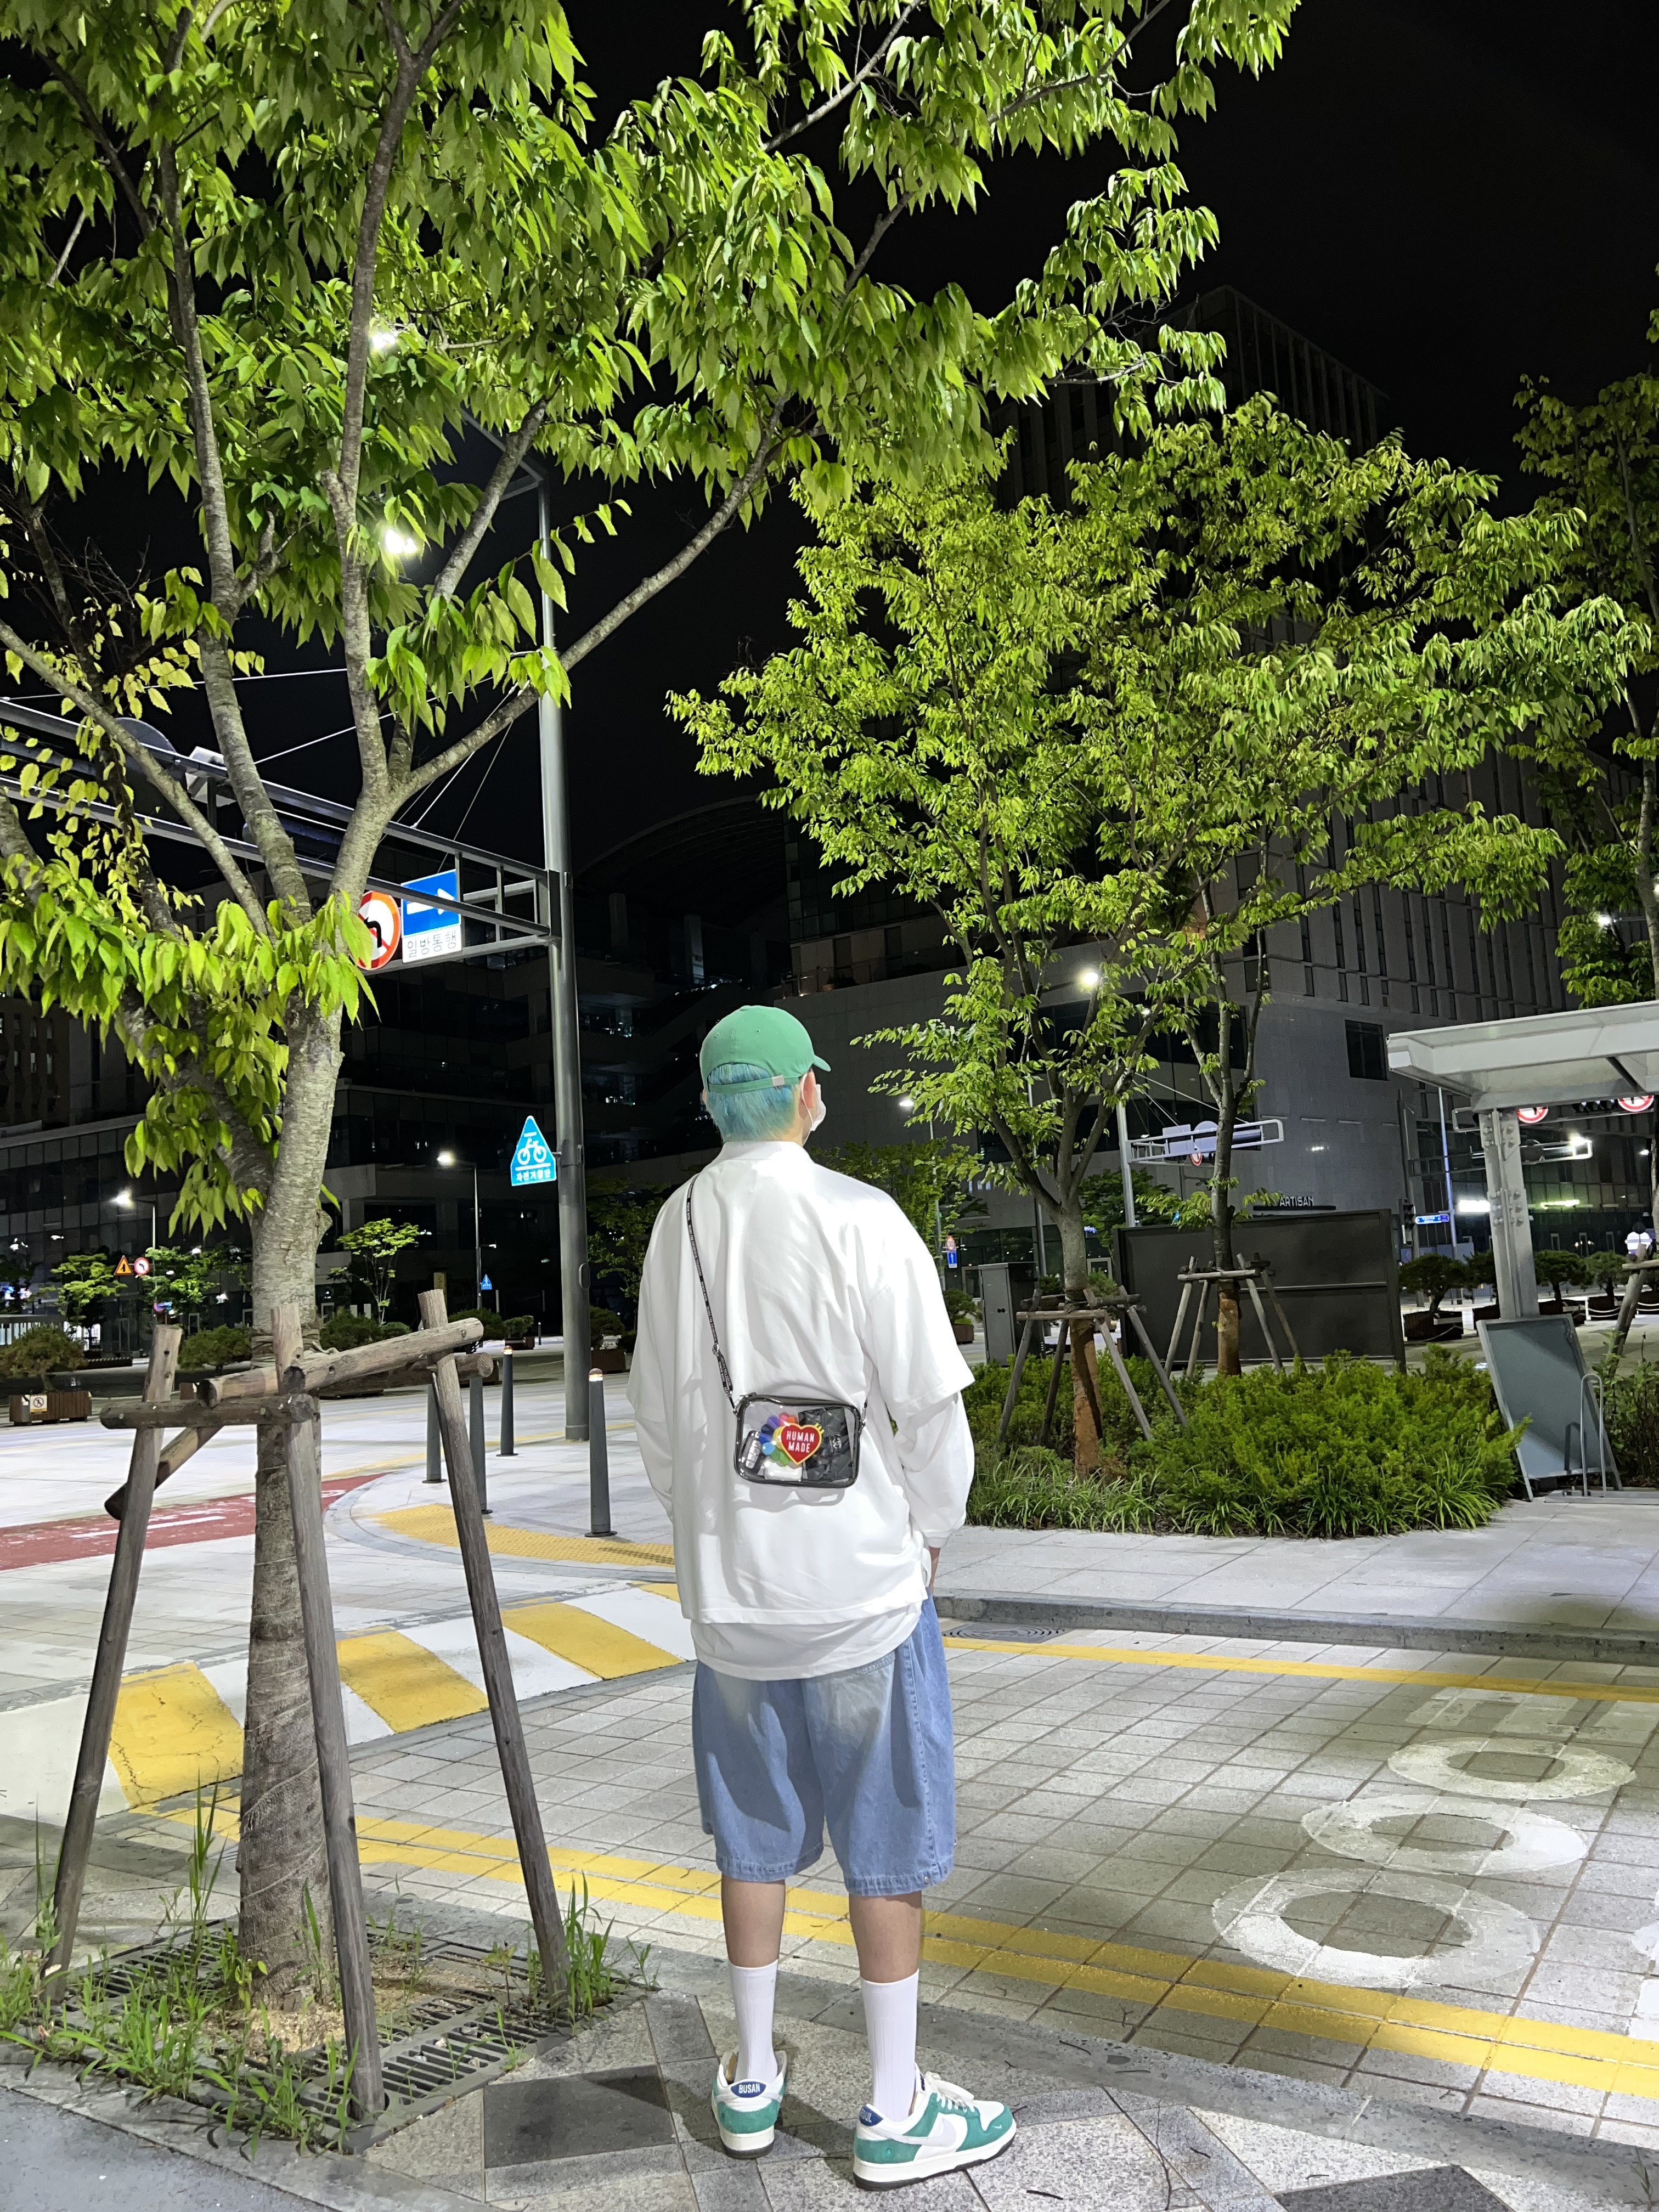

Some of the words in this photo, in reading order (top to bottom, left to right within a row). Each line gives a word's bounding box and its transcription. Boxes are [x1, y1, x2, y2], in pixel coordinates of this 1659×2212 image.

[408, 930, 456, 958] 일방통행
[1279, 1196, 1314, 1206] ARTISAN
[786, 1430, 815, 1442] HUMAN
[788, 1441, 811, 1453] MADE
[738, 2083, 760, 2094] BUSAN
